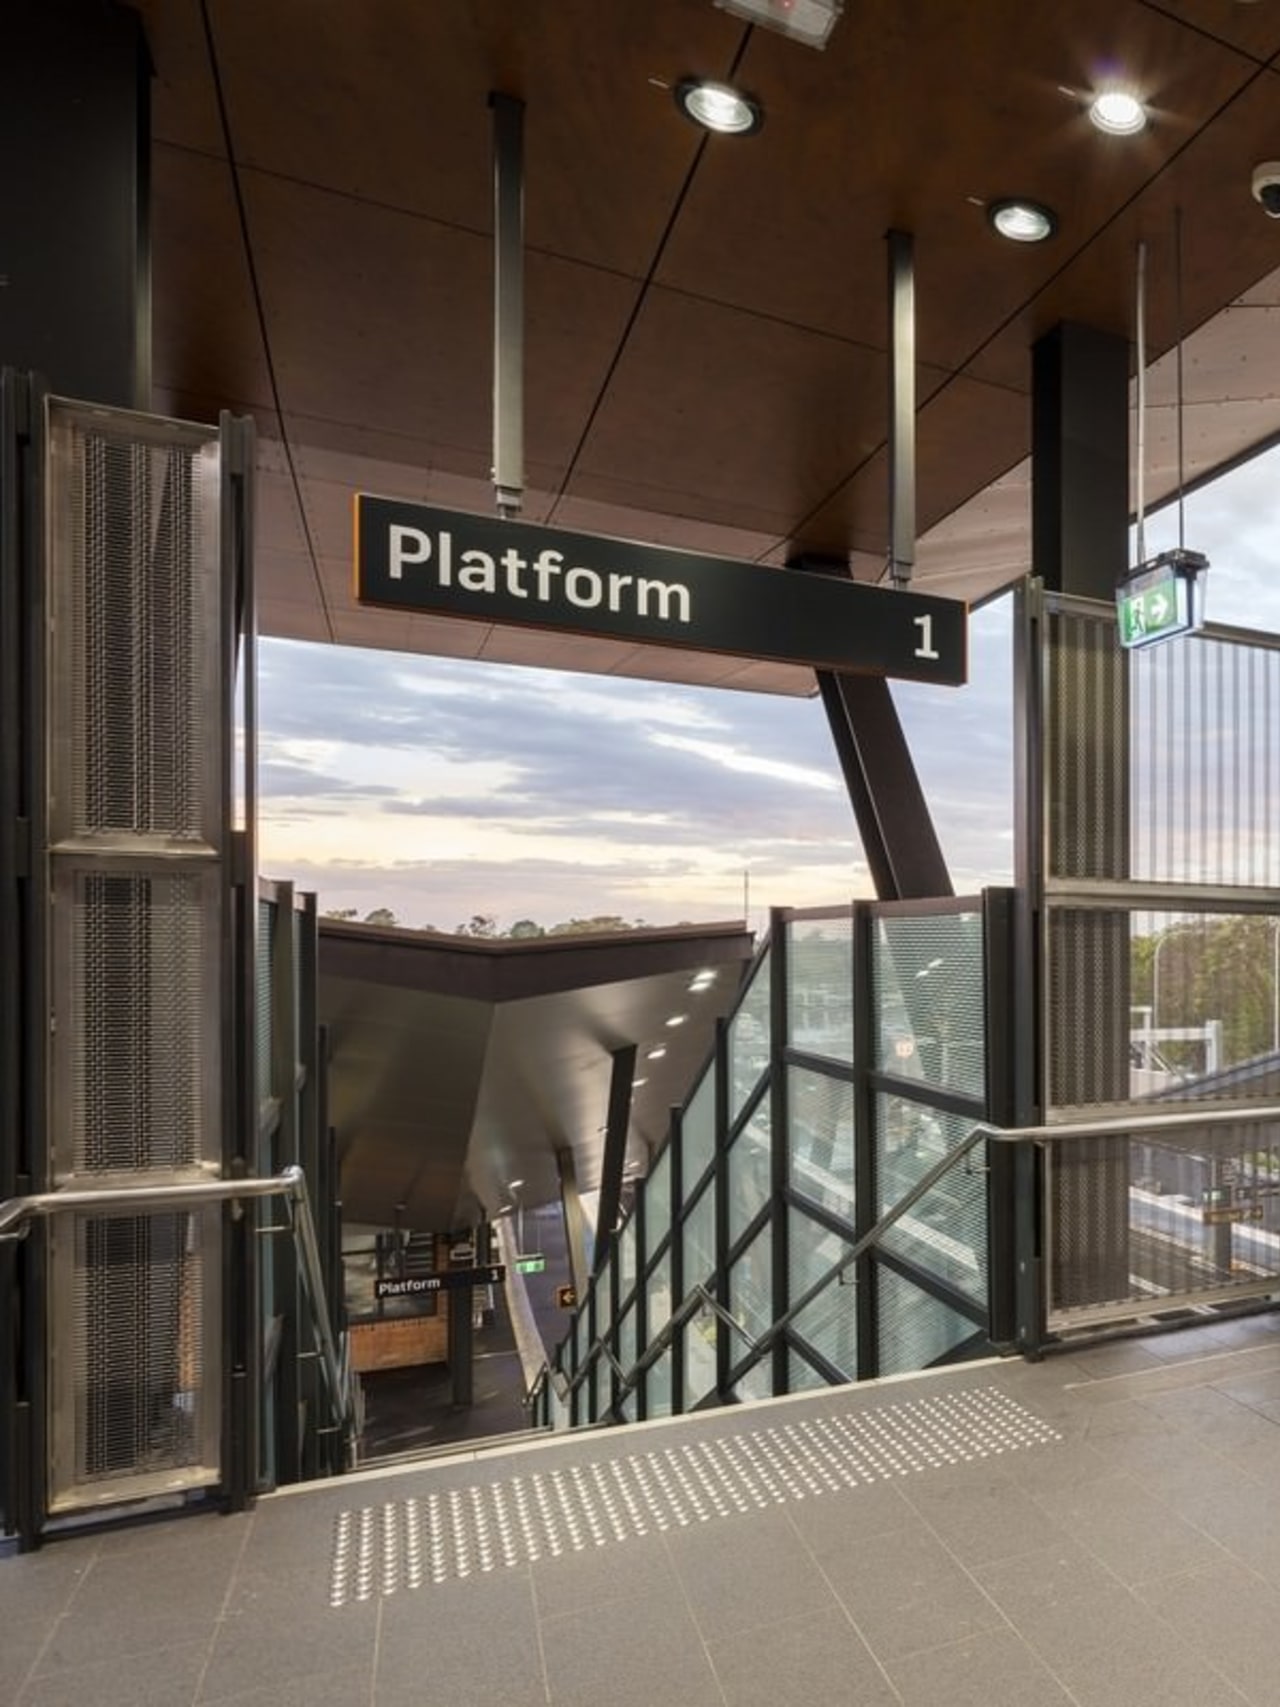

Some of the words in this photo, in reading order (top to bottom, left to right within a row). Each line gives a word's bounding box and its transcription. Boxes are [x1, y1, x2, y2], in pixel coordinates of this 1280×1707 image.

[389, 524, 691, 622] Platform
[913, 613, 939, 661] 1
[379, 1279, 441, 1295] Platform
